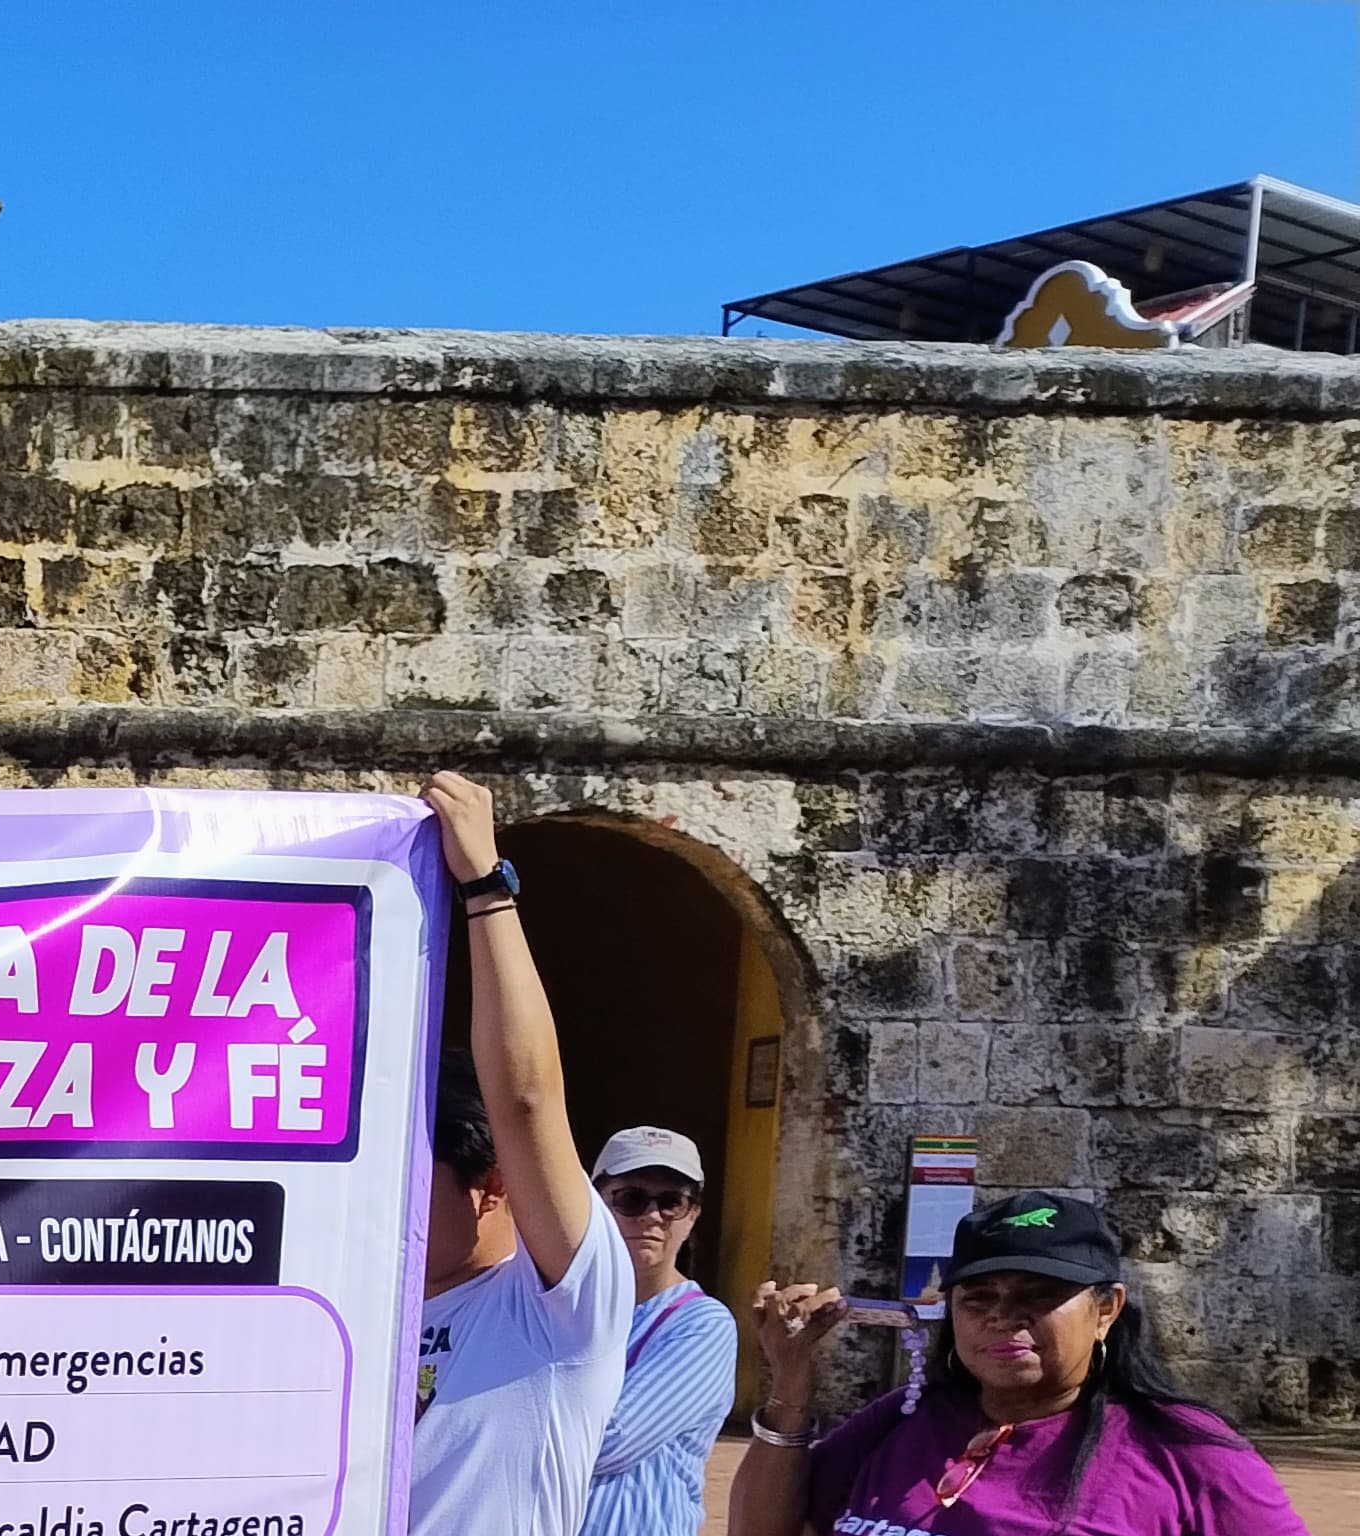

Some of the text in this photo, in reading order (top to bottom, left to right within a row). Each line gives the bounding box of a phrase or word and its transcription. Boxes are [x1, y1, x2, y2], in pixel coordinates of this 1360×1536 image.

[69, 925, 185, 1016] DE
[192, 931, 299, 1018] LA
[135, 1043, 196, 1128] Y
[228, 1015, 327, 1130] FÉ
[41, 1209, 254, 1263] CONTÁCTANOS
